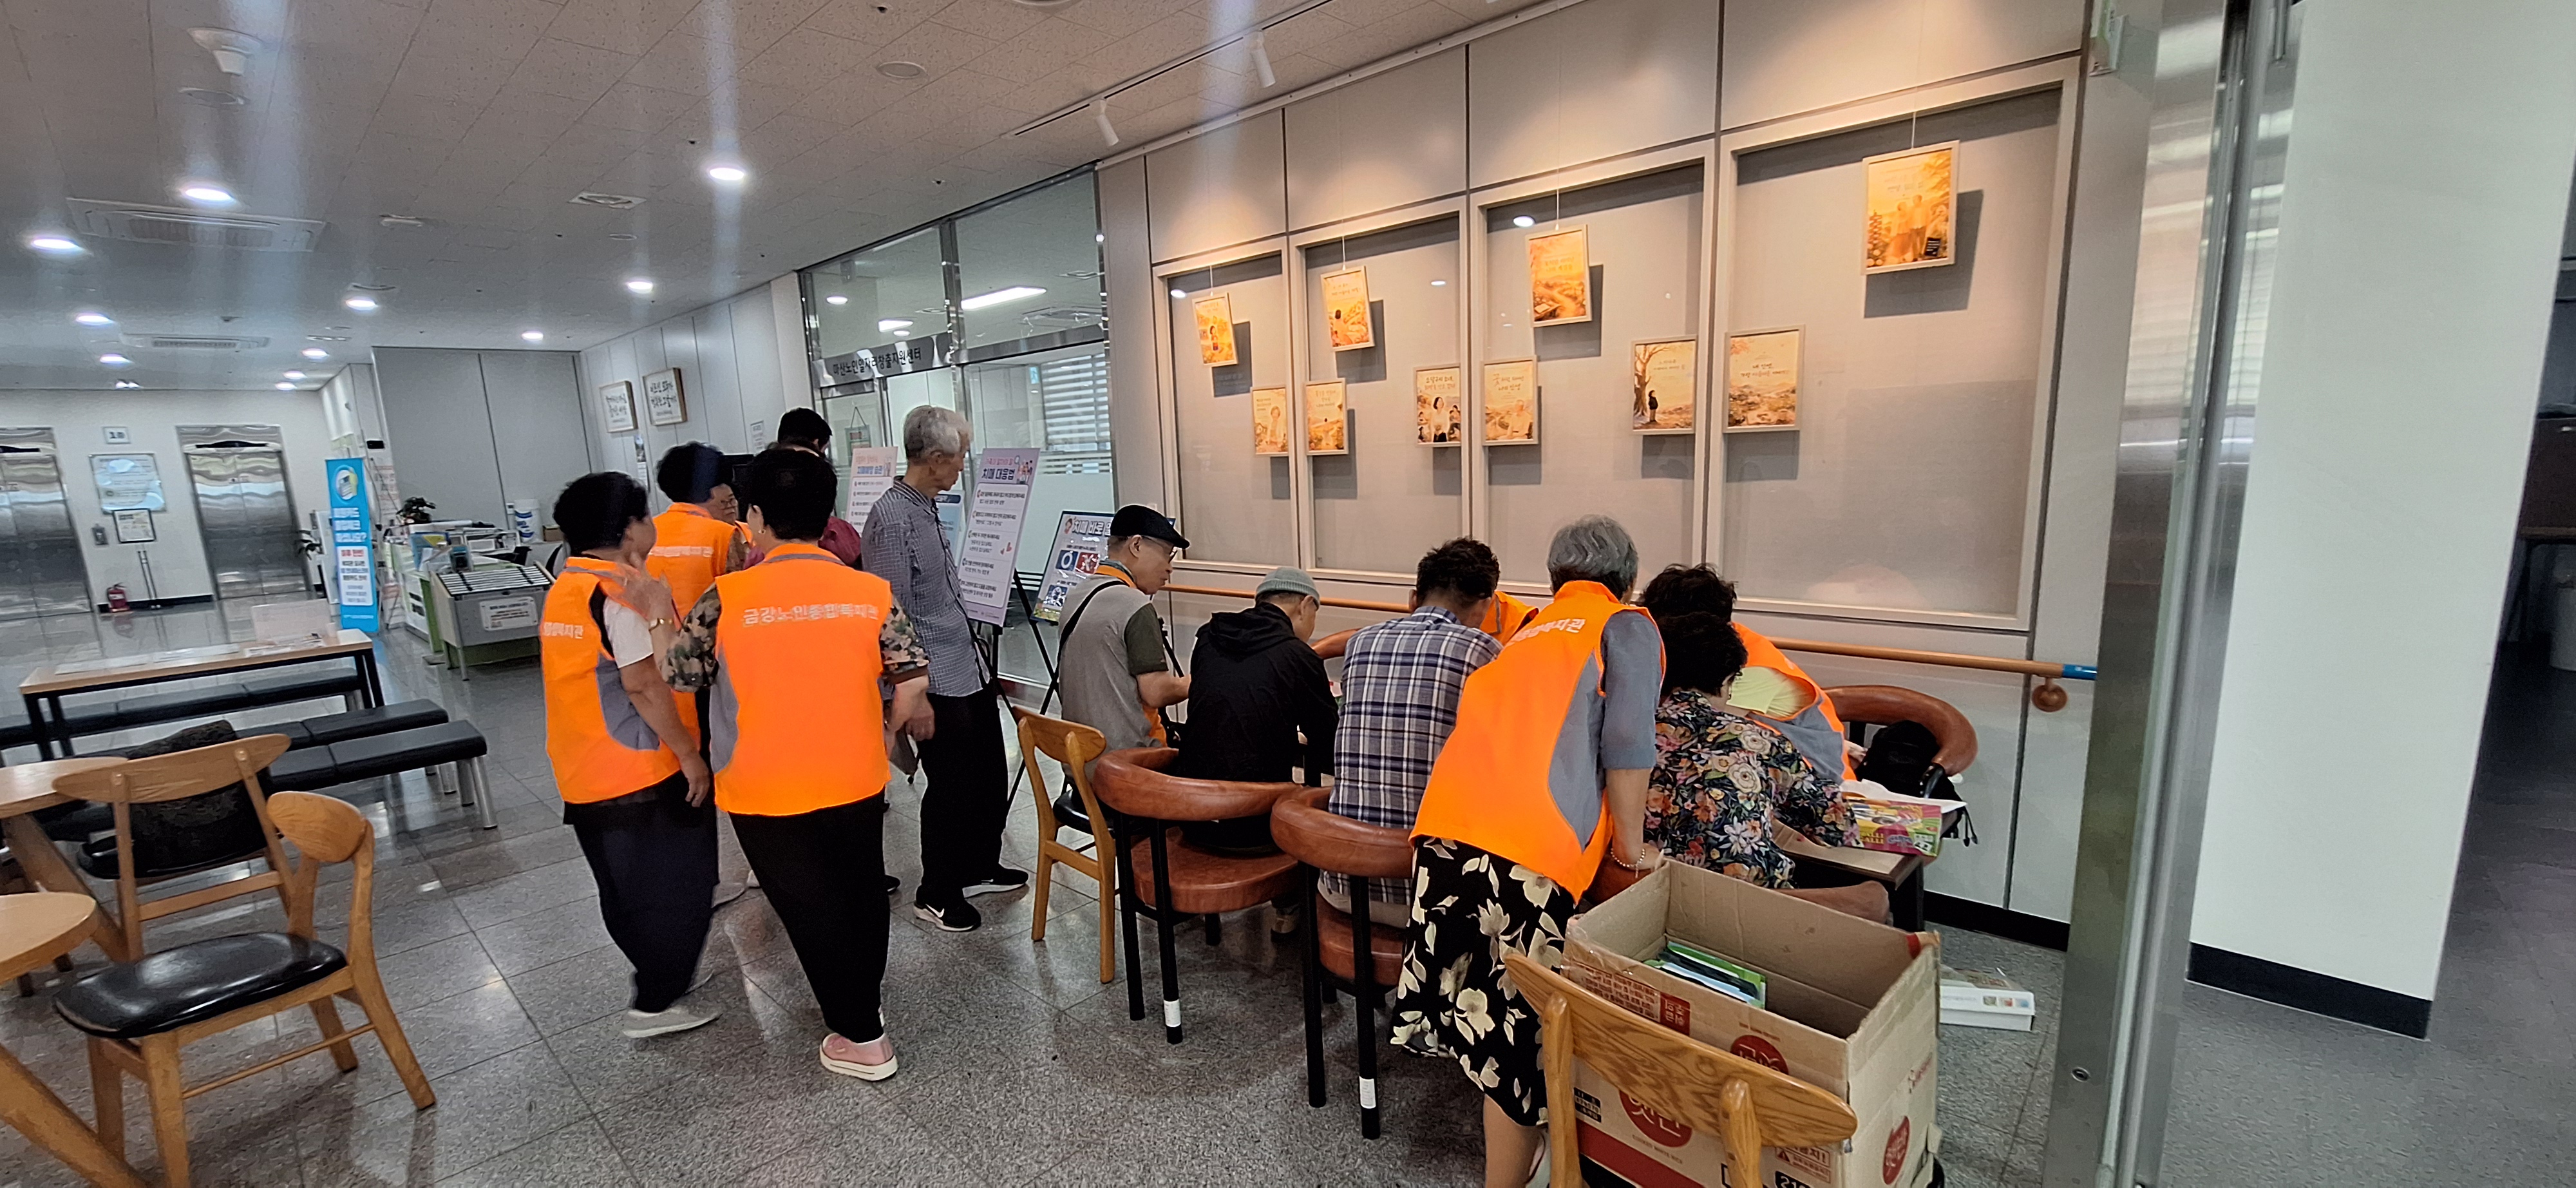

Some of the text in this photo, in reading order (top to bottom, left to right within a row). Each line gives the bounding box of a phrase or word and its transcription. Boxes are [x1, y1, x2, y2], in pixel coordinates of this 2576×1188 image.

[833, 347, 922, 376] 마산노인일자리창출지원센터
[981, 468, 1016, 480] 치매 대응법
[1072, 519, 1089, 535] 치매
[1088, 521, 1104, 536] 바로
[743, 603, 879, 625] 금강노인종합복지관
